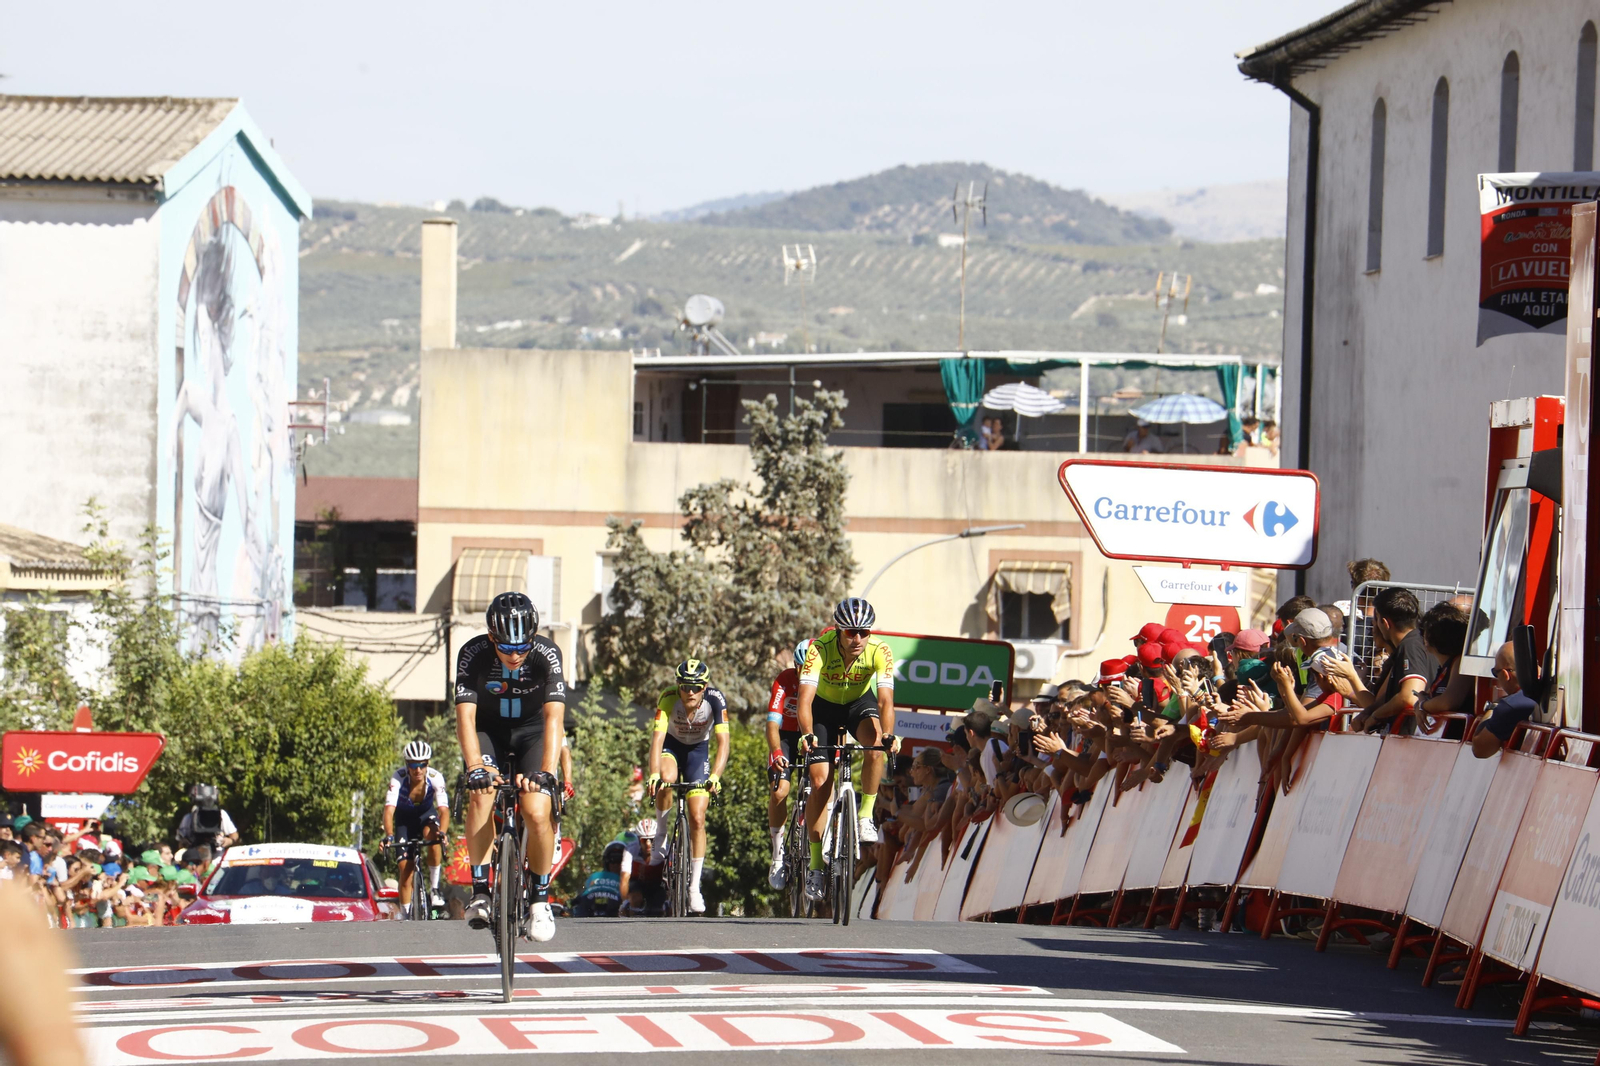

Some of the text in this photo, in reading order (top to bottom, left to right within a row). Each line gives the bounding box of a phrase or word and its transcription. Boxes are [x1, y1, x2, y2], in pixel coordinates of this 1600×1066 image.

[1501, 209, 1527, 221] RONDA
[1532, 243, 1558, 253] CON
[1498, 261, 1570, 281] LA VUEL
[1500, 291, 1570, 306] FINAL ETA
[1523, 304, 1556, 317] AQUÍ
[1094, 496, 1231, 527] Carrefour
[1160, 579, 1213, 592] Carrefour
[1184, 614, 1222, 643] 25
[457, 640, 489, 677] youfone
[531, 641, 562, 675] youfone
[802, 644, 823, 676] ARKEA
[880, 645, 894, 679] ARKEA
[821, 672, 872, 682] ARKEA
[893, 659, 994, 688] KODA
[897, 719, 938, 731] Carrefour
[47, 750, 139, 773] Cofidis
[1564, 832, 1600, 910] Carre
[81, 950, 937, 987] COFIDIS
[116, 1011, 1113, 1061] COFIDIS
